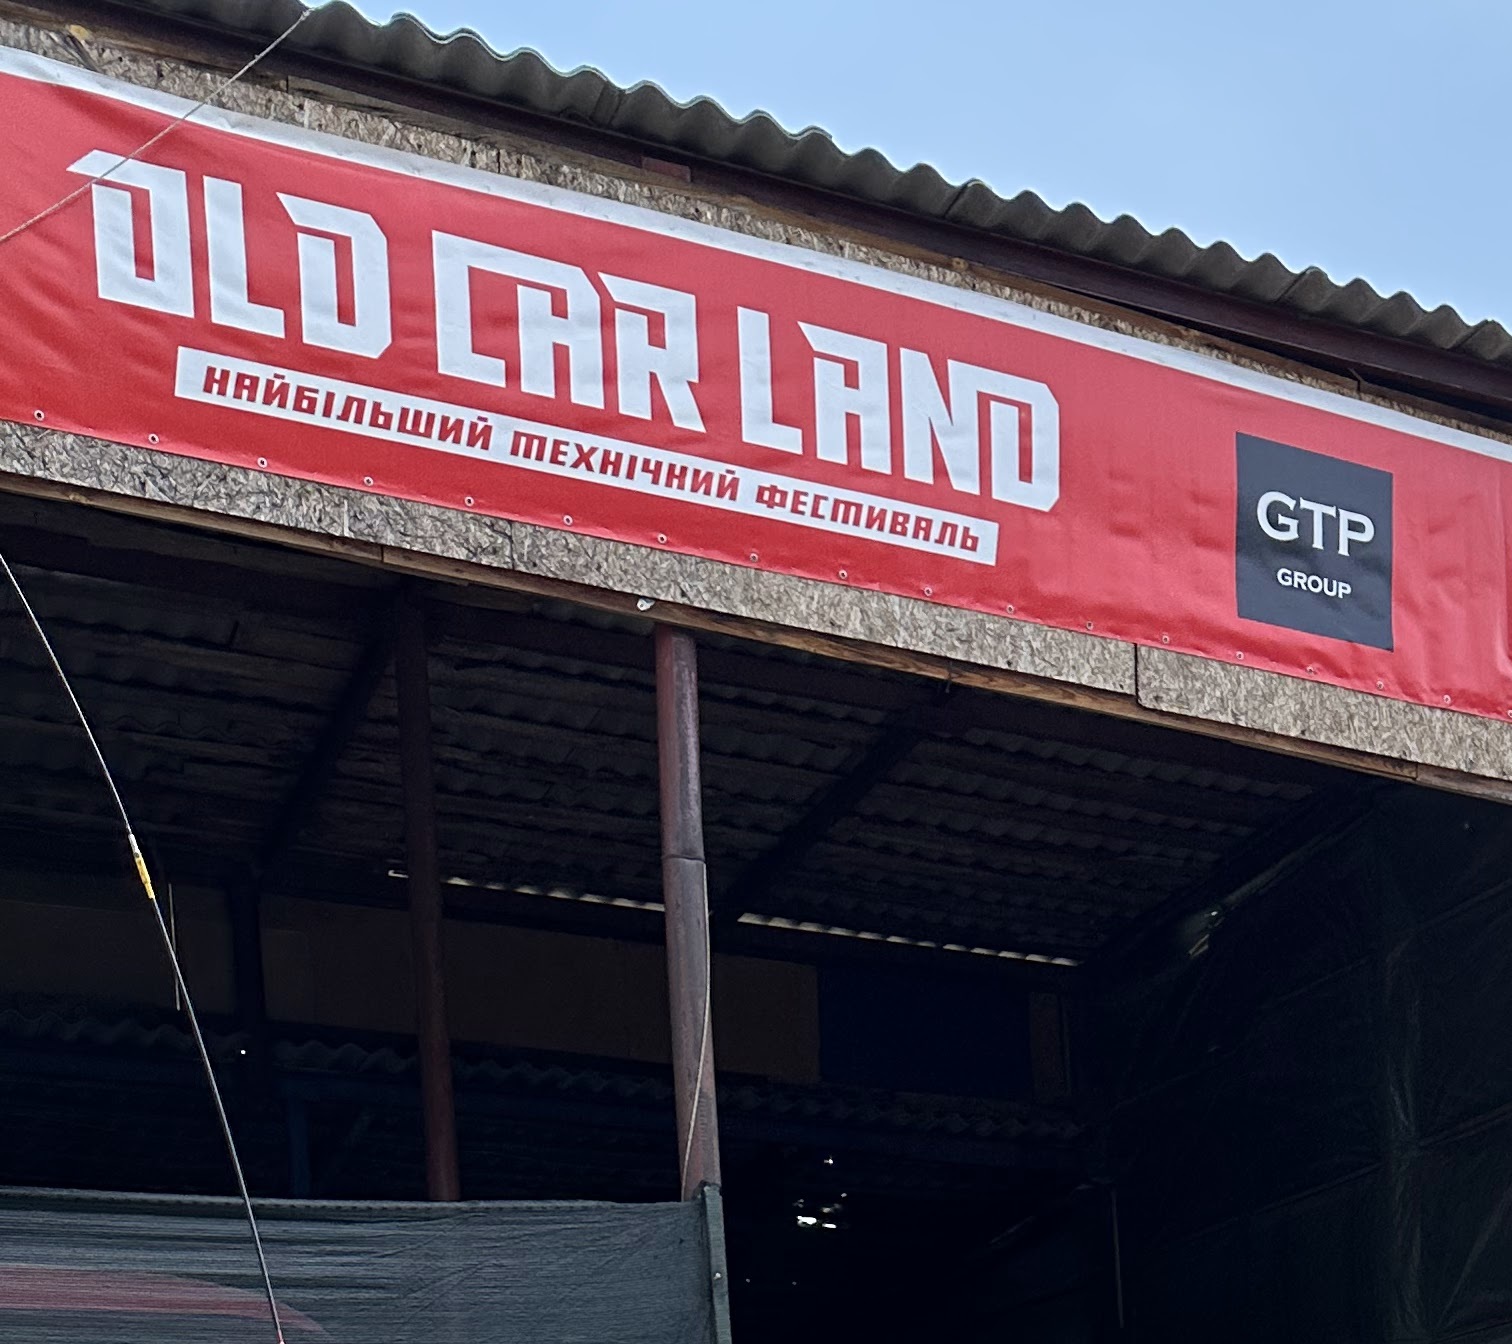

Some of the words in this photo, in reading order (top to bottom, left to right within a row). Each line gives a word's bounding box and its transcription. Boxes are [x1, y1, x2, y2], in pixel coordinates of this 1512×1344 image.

[67, 150, 392, 358] OLD
[432, 230, 706, 433] CAR
[738, 307, 1060, 511] LAND
[203, 365, 492, 450] НАЙБІЛЬШИЙ
[511, 432, 739, 501] ТЕХНІЧНИЙ
[756, 484, 979, 551] ФЕСТИВАЛЬ
[1256, 491, 1375, 557] GTP
[1276, 567, 1352, 599] GROUP
